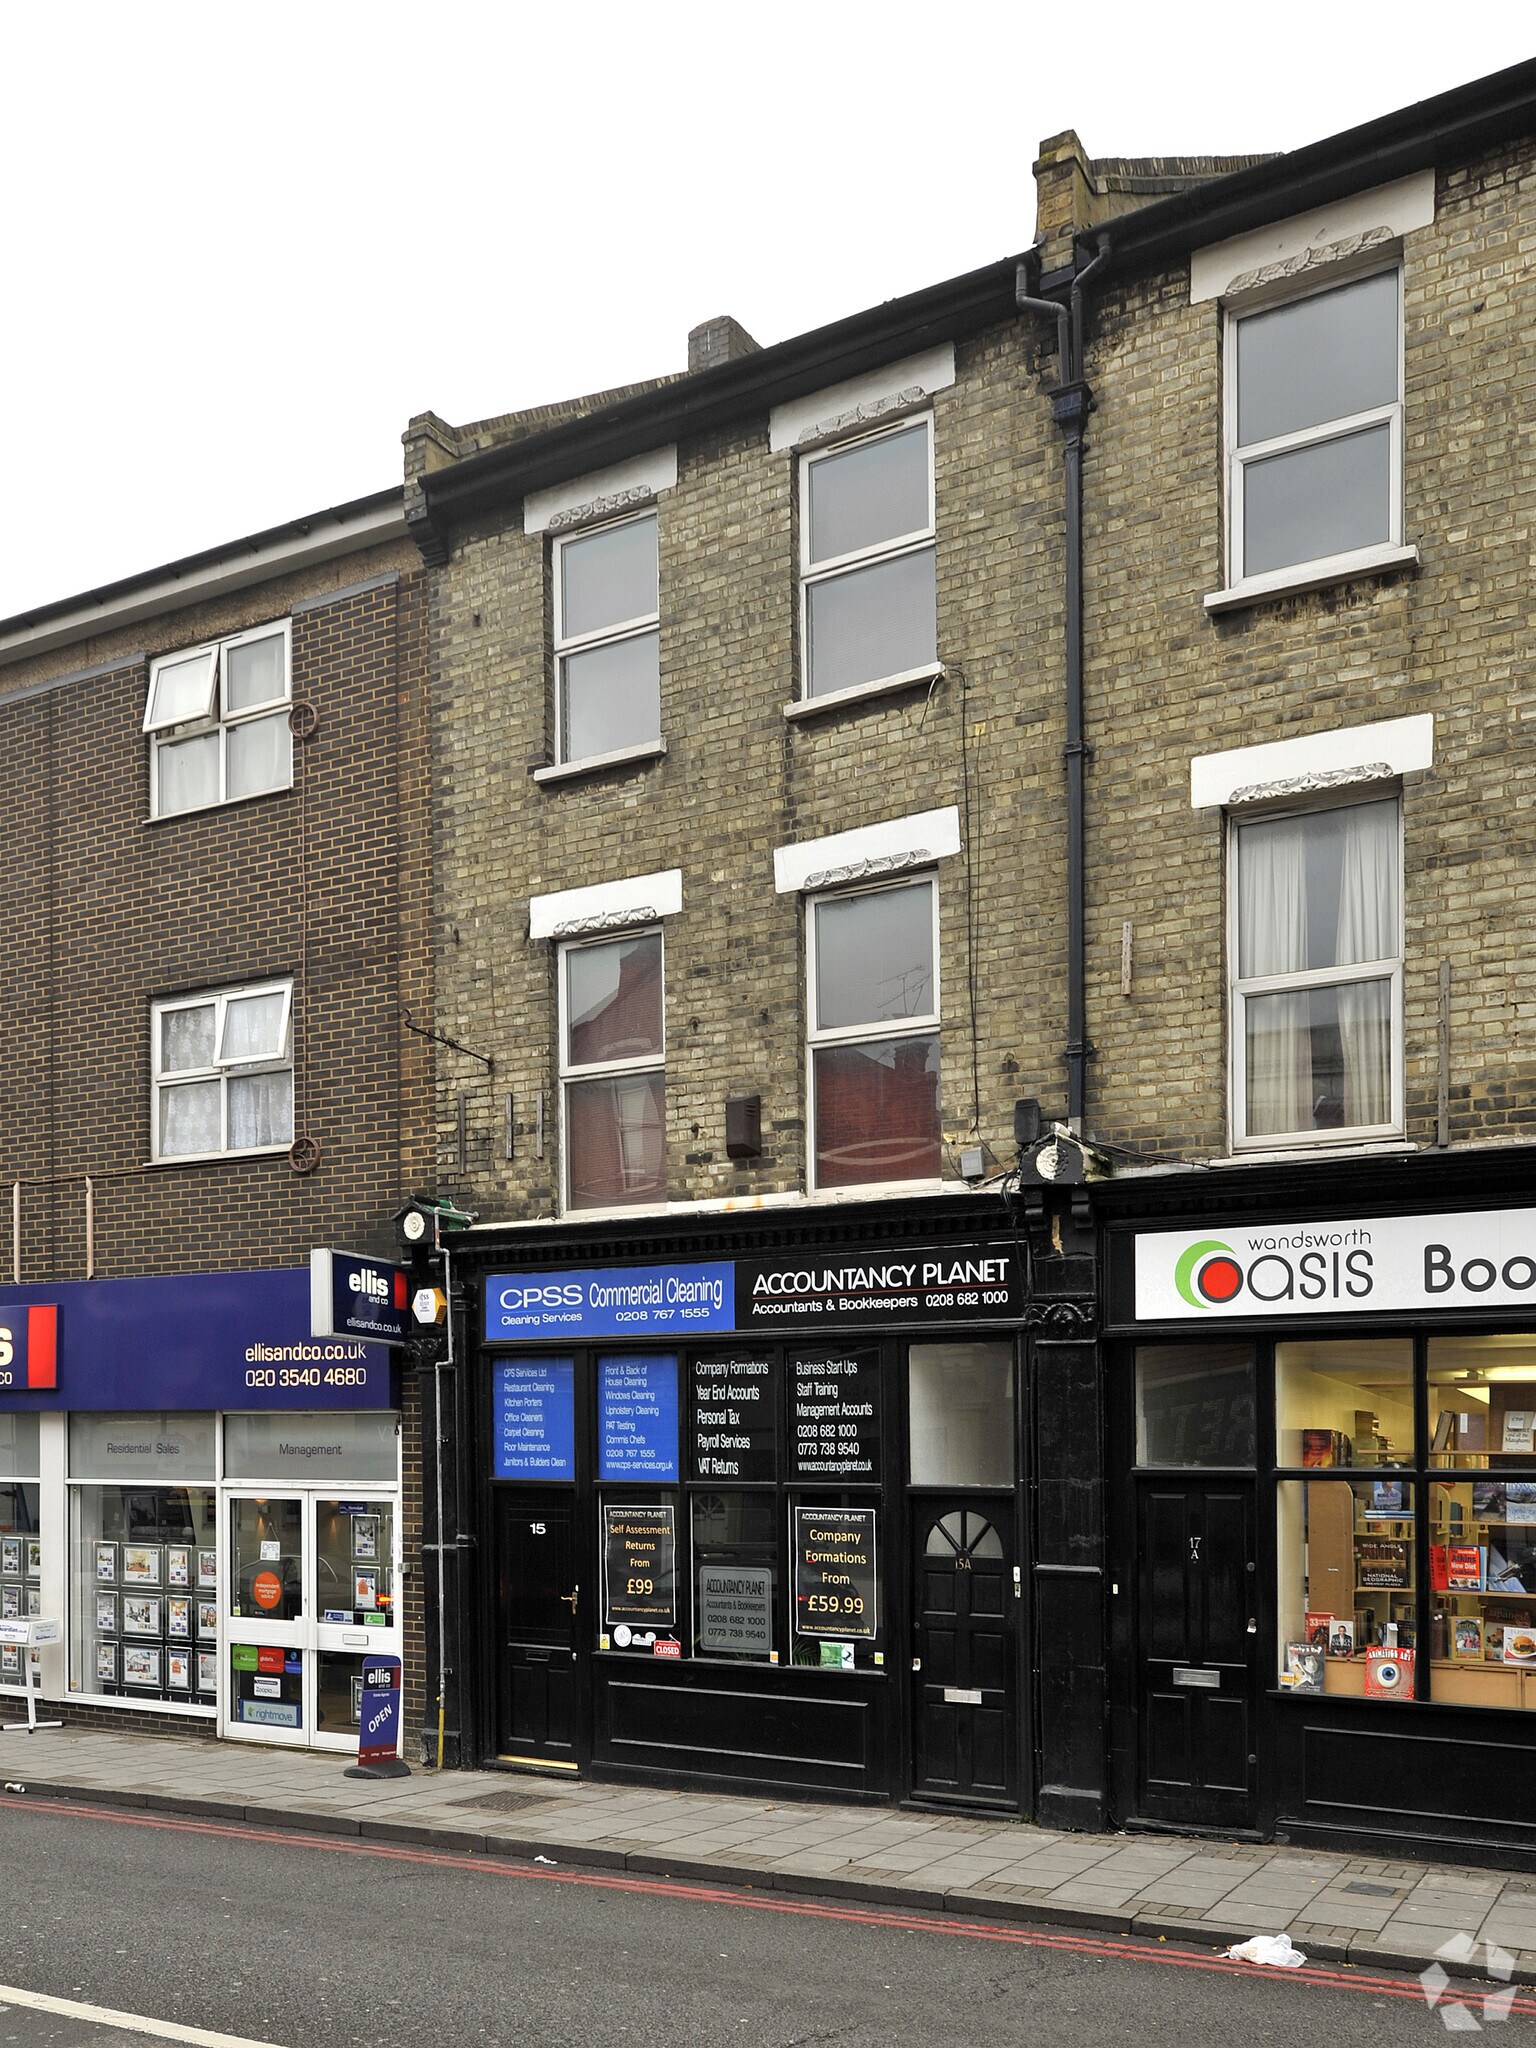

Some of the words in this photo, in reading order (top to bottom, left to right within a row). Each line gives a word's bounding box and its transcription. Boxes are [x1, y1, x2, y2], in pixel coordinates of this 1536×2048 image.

[1248, 1228, 1372, 1251] wandsworth
[348, 1268, 389, 1297] ellis
[752, 1264, 917, 1296] ACCOUNTANCY
[922, 1258, 1010, 1286] PLANET
[368, 1295, 380, 1304] and
[499, 1284, 584, 1310] CPSS
[589, 1278, 664, 1308] Commercial
[665, 1276, 724, 1310] Cleaning
[752, 1299, 824, 1315] Accountants
[825, 1299, 836, 1311] &
[839, 1295, 919, 1311] Bookkeepers
[925, 1293, 954, 1308] 0208
[957, 1292, 979, 1306] 682
[982, 1290, 1009, 1304] 1000
[501, 1314, 540, 1327] Cleaning
[542, 1312, 583, 1324] Services
[615, 1311, 648, 1322] 0208
[652, 1309, 676, 1320] 767
[679, 1307, 710, 1318] 1555
[346, 1317, 402, 1334] ellisandco.co.uk
[245, 1341, 367, 1362] ellisandco.co.uk
[504, 1369, 515, 1377] CPS
[515, 1368, 538, 1377] Services
[538, 1368, 547, 1377] Ltd
[605, 1366, 619, 1375] Front
[620, 1366, 625, 1375] &
[626, 1366, 640, 1375] Back
[641, 1365, 647, 1374] of
[696, 1361, 729, 1378] Company
[730, 1360, 769, 1374] Formations
[796, 1361, 826, 1375] Business
[826, 1360, 843, 1374] Start
[844, 1360, 858, 1376] Ups
[245, 1369, 276, 1387] 020
[279, 1368, 321, 1386] 3540
[323, 1367, 367, 1386] 4680
[605, 1377, 623, 1386] House
[624, 1377, 647, 1387] Cleaning
[504, 1383, 532, 1392] Restaurant
[532, 1382, 555, 1393] Cleaning
[696, 1384, 711, 1400] Year
[712, 1384, 726, 1400] End
[727, 1384, 760, 1400] Accounts
[797, 1382, 813, 1396] Staff
[814, 1382, 838, 1398] Training
[504, 1398, 523, 1407] Kitchen
[524, 1398, 543, 1407] Porters
[605, 1391, 631, 1400] Windows
[632, 1391, 655, 1401] Cleaning
[605, 1406, 635, 1416] Upholstery
[636, 1406, 659, 1416] Cleaning
[697, 1409, 726, 1424] Personal
[727, 1409, 740, 1425] Tax
[797, 1402, 840, 1419] Management
[841, 1402, 873, 1416] Accounts
[504, 1413, 520, 1422] Office
[521, 1413, 543, 1422] Cleaners
[504, 1428, 521, 1438] Carpet
[522, 1428, 544, 1438] Cleaning
[605, 1421, 616, 1430] PAT
[616, 1421, 636, 1432] Testing
[797, 1425, 818, 1437] 0208
[820, 1424, 836, 1437] 682
[837, 1424, 858, 1437] 1000
[606, 1435, 629, 1444] Commis
[629, 1435, 646, 1444] Chefs
[697, 1433, 719, 1451] Payroll
[720, 1433, 751, 1449] Services
[107, 1443, 152, 1454] Residential
[156, 1443, 180, 1454] Sales
[279, 1443, 342, 1458] Management
[517, 1442, 551, 1452] Maintenance
[606, 1450, 624, 1458] 0208
[626, 1450, 638, 1458] 767
[639, 1449, 656, 1458] 1555
[797, 1442, 818, 1455] 0773
[819, 1442, 836, 1455] 738
[838, 1442, 860, 1455] 9540
[504, 1458, 524, 1467] Janitors
[524, 1458, 529, 1467] &
[530, 1457, 550, 1467] Builders
[551, 1457, 567, 1467] Clean
[698, 1457, 711, 1474] VAT
[711, 1457, 739, 1475] Returns
[801, 1513, 843, 1521] ACCOUNTANCY
[844, 1514, 867, 1522] PLANET
[530, 1523, 547, 1535] 15
[610, 1525, 624, 1534] Self
[625, 1525, 671, 1535] Assessment
[809, 1529, 861, 1545] Company
[1189, 1537, 1202, 1549] 17
[625, 1541, 656, 1551] Returns
[805, 1550, 867, 1565] Formations
[1190, 1549, 1199, 1559] A
[1451, 1554, 1477, 1563] Atkins
[630, 1558, 650, 1568] From
[1464, 1562, 1477, 1570] Diet
[822, 1572, 851, 1585] From
[627, 1578, 653, 1595] £99
[706, 1579, 745, 1594] ACCOUNTANCY
[746, 1580, 766, 1596] PLANET
[808, 1595, 864, 1615] £59.99
[707, 1615, 727, 1624] 0208
[730, 1616, 744, 1624] 682
[747, 1617, 766, 1625] 1000
[708, 1628, 726, 1637] 0773
[728, 1629, 743, 1637] 738
[745, 1630, 766, 1639] 9540
[656, 1645, 680, 1655] CLOSED
[368, 1669, 391, 1684] ellis
[256, 1709, 293, 1722] rightmove
[368, 1704, 393, 1733] OPEN
